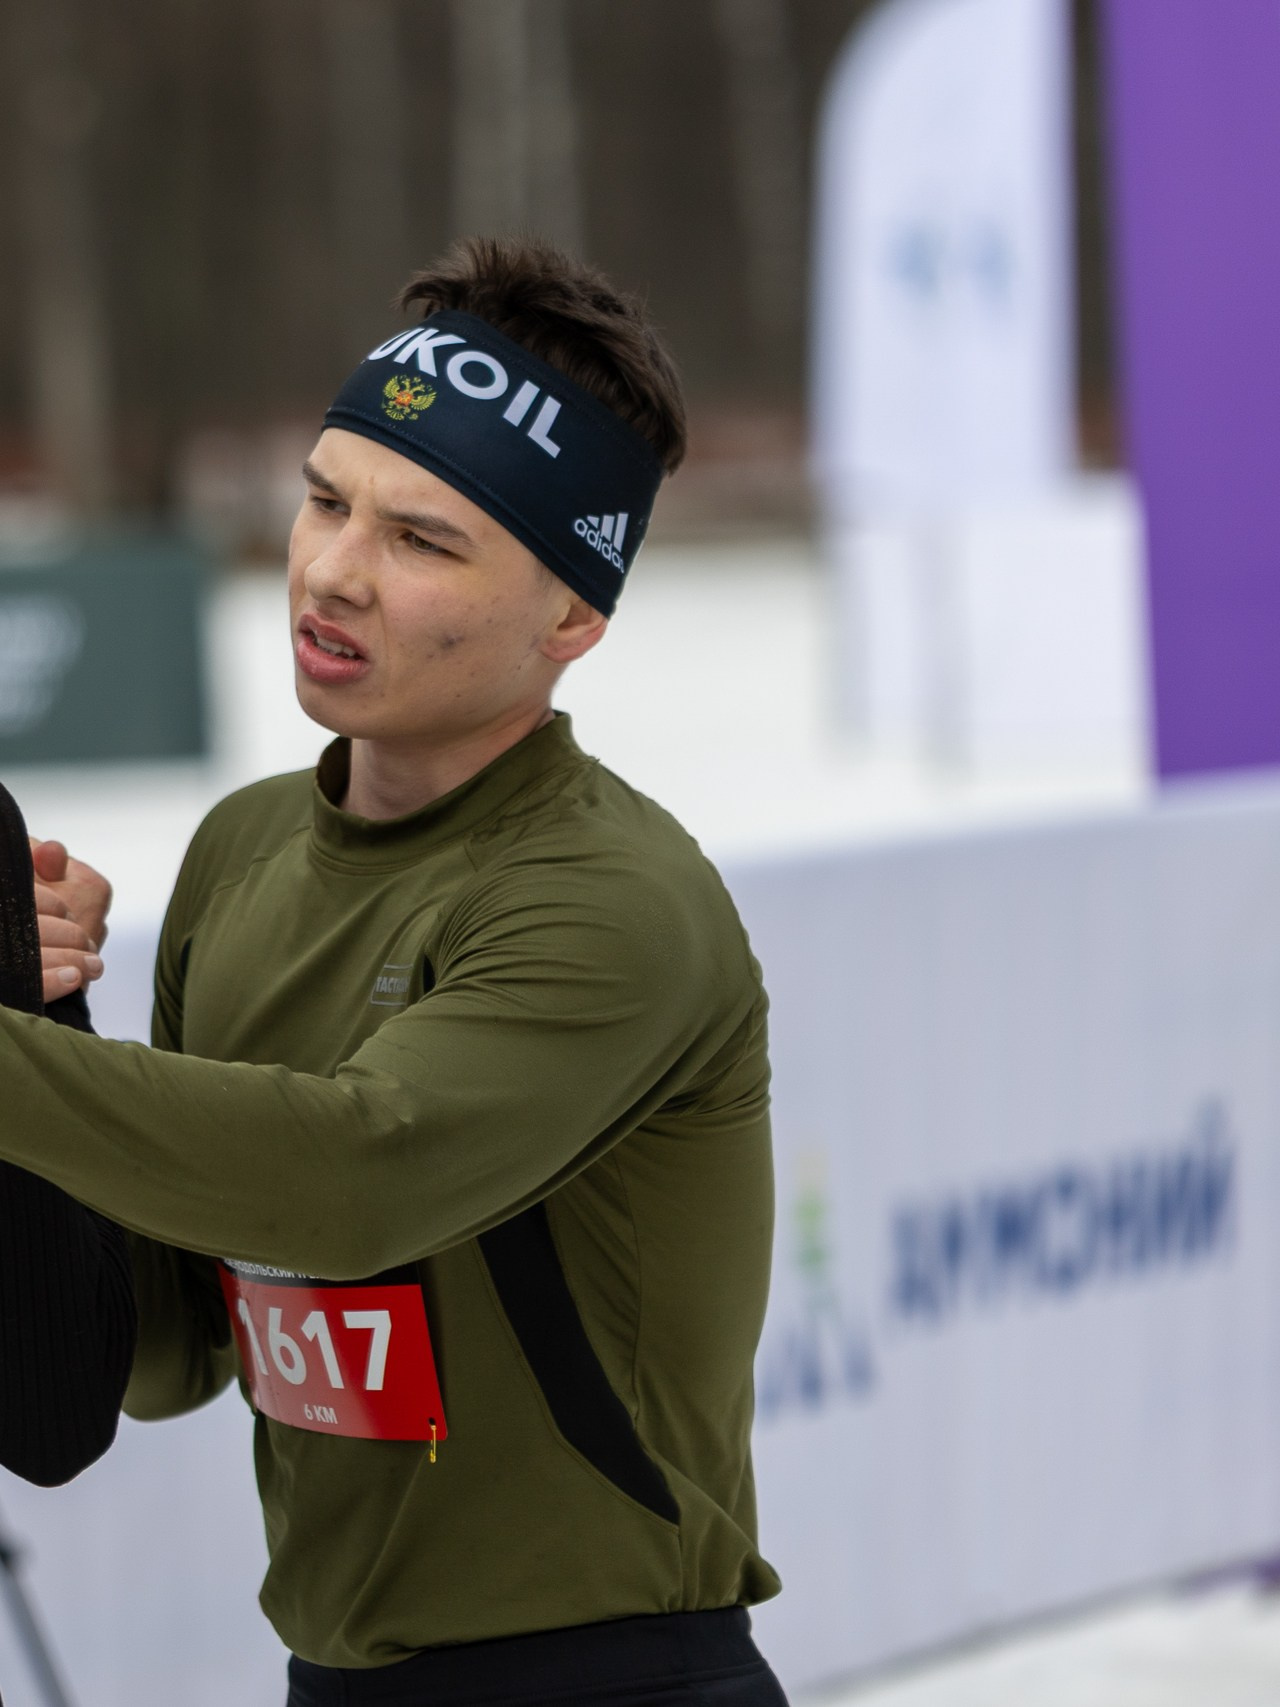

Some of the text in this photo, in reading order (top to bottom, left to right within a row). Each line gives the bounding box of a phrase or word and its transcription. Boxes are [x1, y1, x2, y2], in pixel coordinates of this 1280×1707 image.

[366, 327, 562, 459] UKOIL
[574, 518, 625, 574] adidas
[237, 1298, 392, 1391] 1617
[303, 1403, 314, 1420] 6
